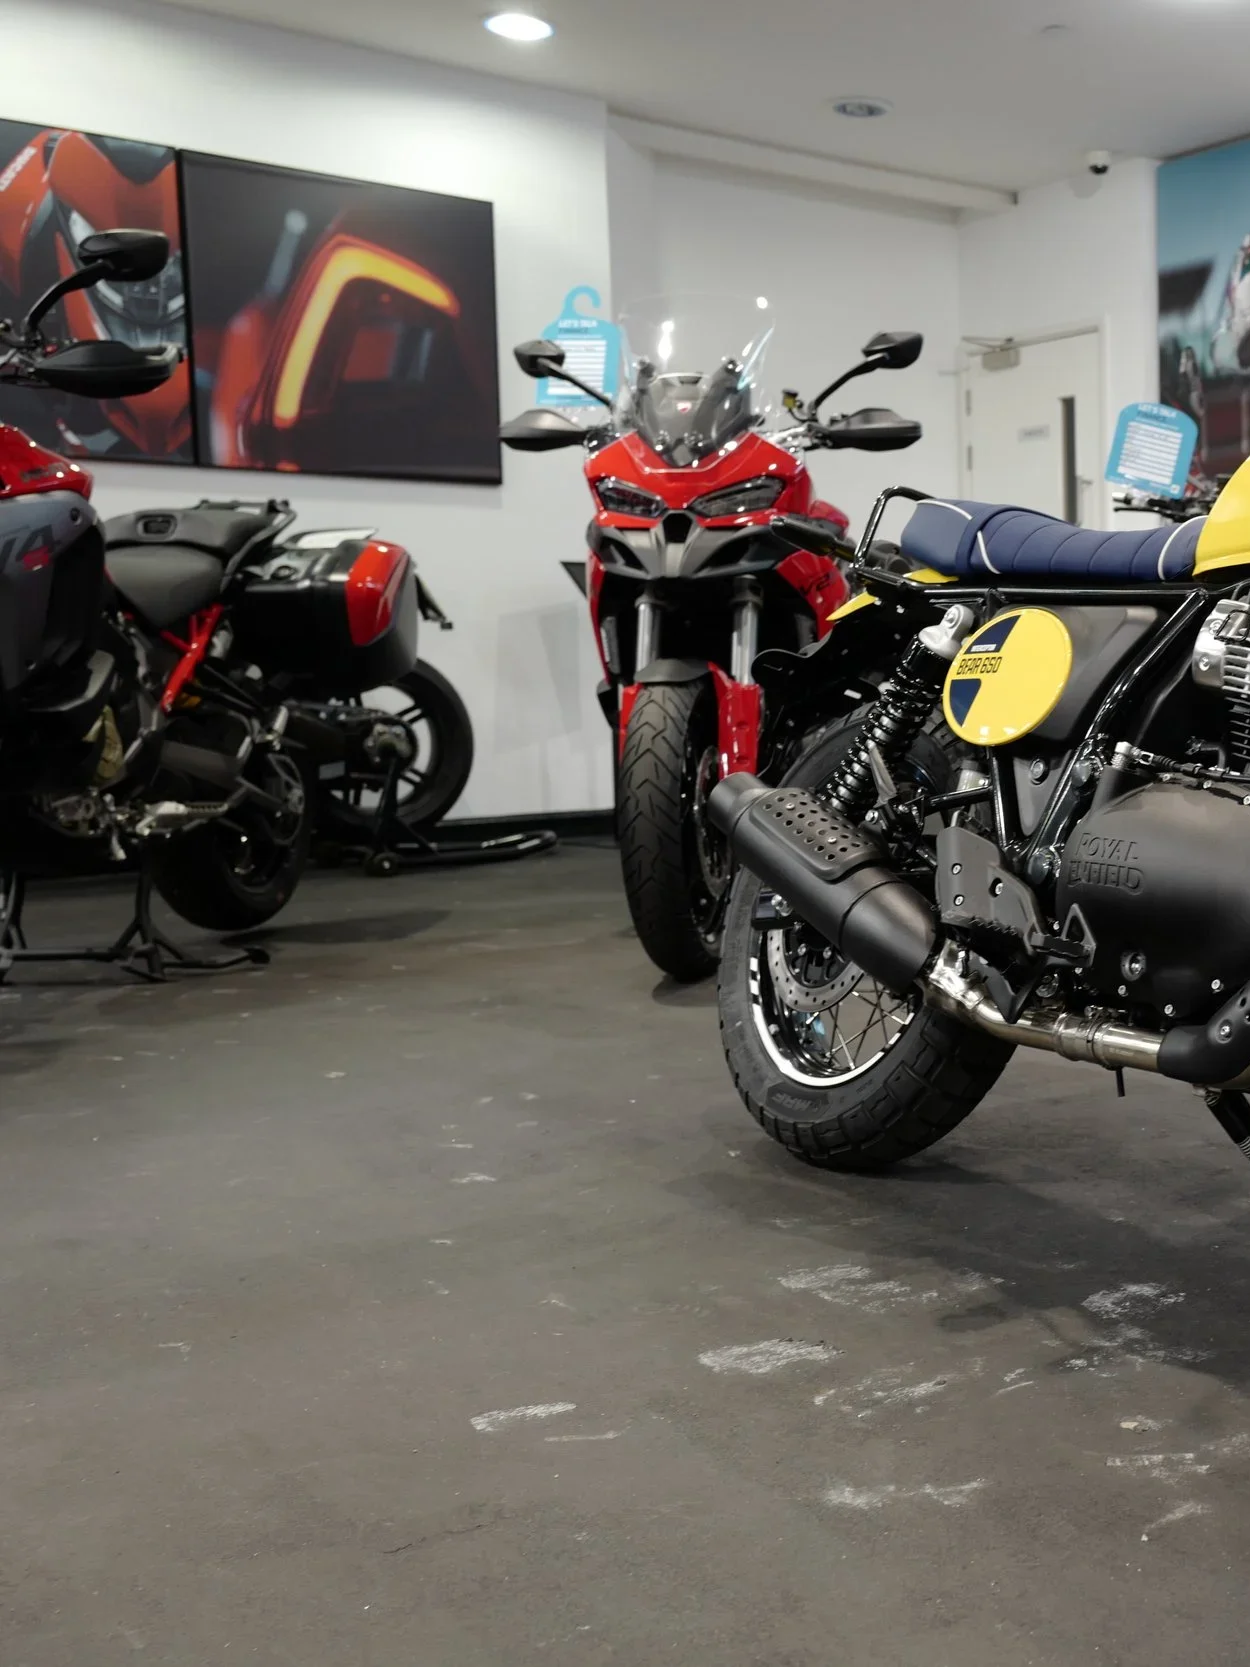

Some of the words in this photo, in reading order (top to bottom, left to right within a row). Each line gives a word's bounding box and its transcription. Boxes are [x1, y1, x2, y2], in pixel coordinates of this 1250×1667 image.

[956, 658, 981, 675] BEAR
[980, 656, 1003, 674] 650
[1075, 832, 1139, 862] ROYAL
[1066, 860, 1145, 896] ENFIELD
